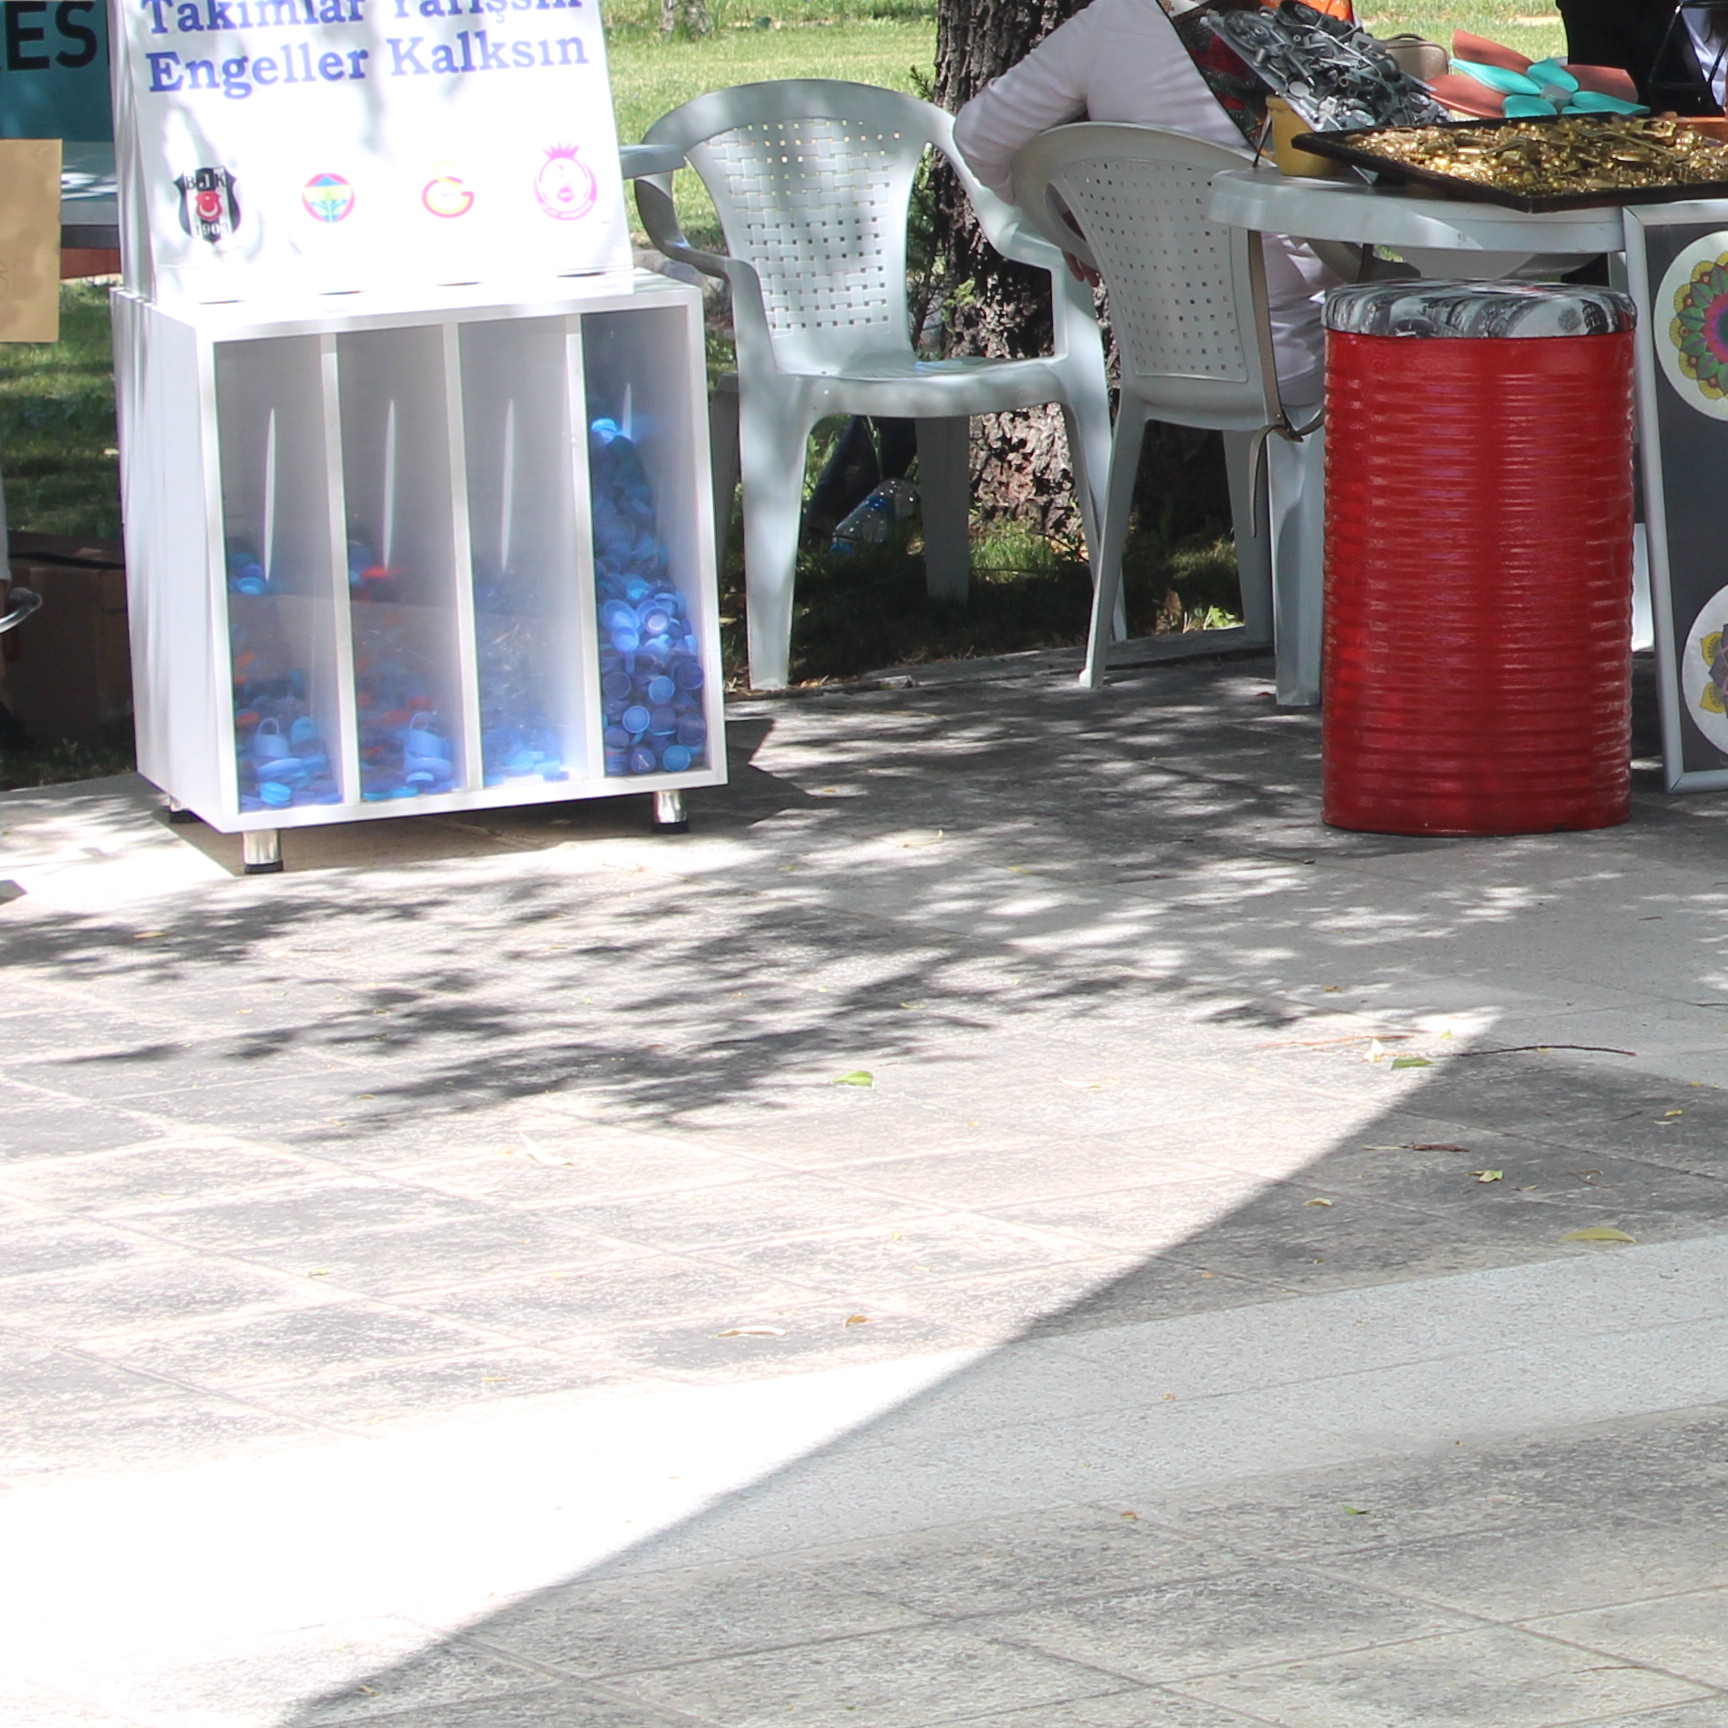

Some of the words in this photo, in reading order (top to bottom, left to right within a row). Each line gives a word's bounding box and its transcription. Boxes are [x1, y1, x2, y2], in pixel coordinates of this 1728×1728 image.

[145, 42, 369, 99] Engeller
[386, 30, 589, 76] Kalksın
[185, 173, 226, 190] BJK
[195, 223, 230, 235] 1903
